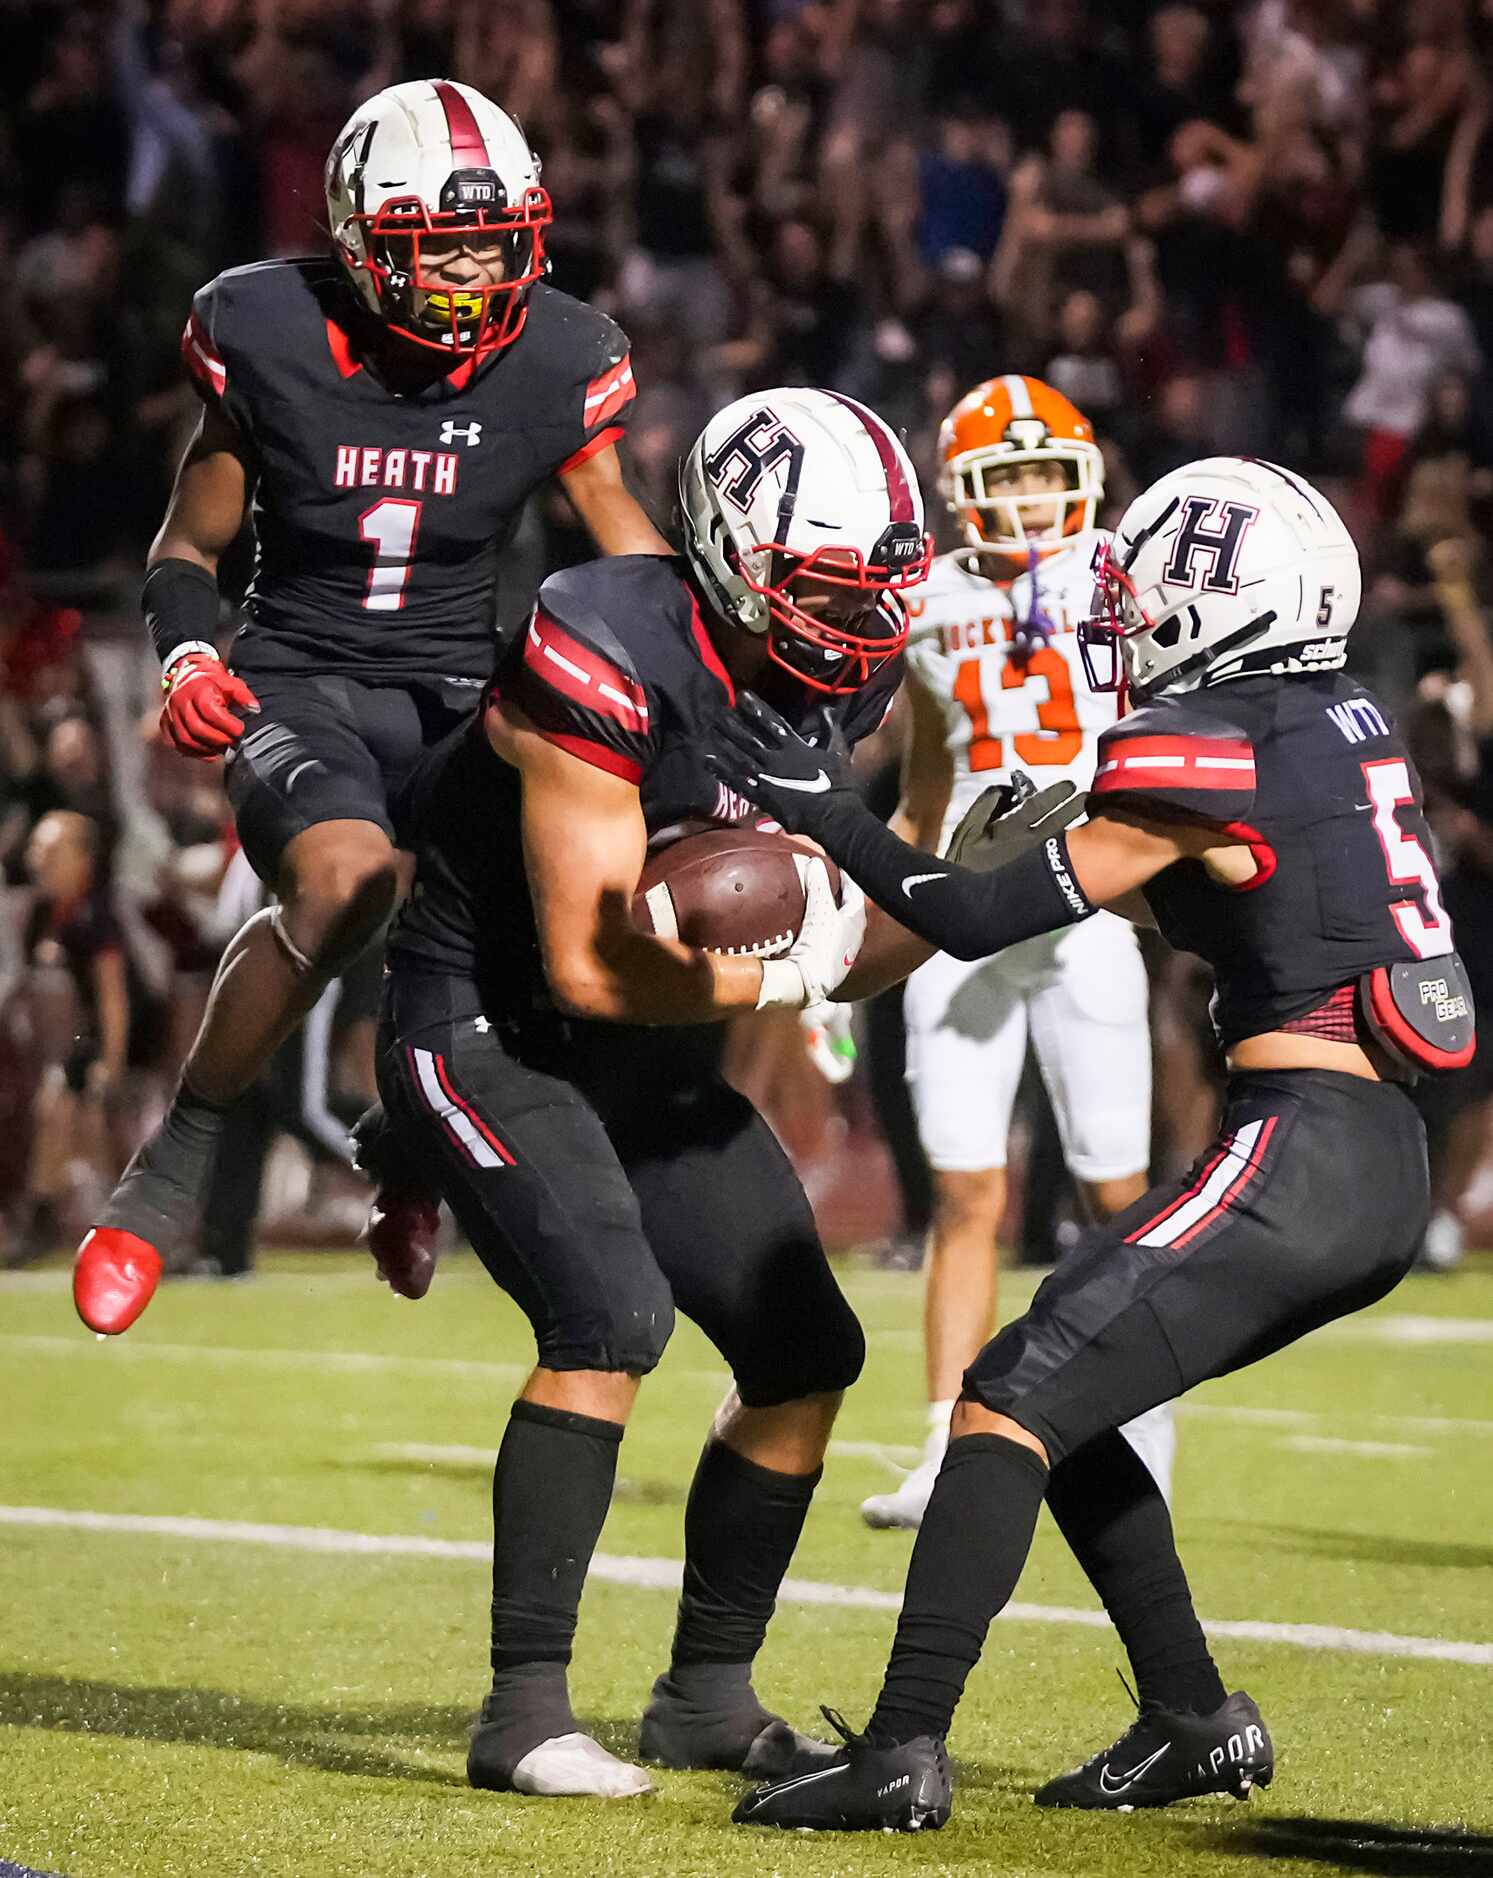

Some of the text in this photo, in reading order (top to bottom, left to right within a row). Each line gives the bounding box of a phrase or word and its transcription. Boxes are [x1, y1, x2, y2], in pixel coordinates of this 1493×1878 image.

[461, 185, 491, 201] WTD
[335, 445, 458, 496] HEATH
[706, 406, 804, 516] H
[358, 497, 423, 611] 1
[894, 542, 915, 556] WTD
[1162, 496, 1260, 596] H
[1316, 585, 1335, 628] 5
[953, 647, 1083, 773] 13
[1045, 838, 1088, 914] NIKE PRO
[1360, 757, 1454, 960] 5
[1418, 979, 1449, 1005] PRO
[1435, 996, 1468, 1022] GEAR
